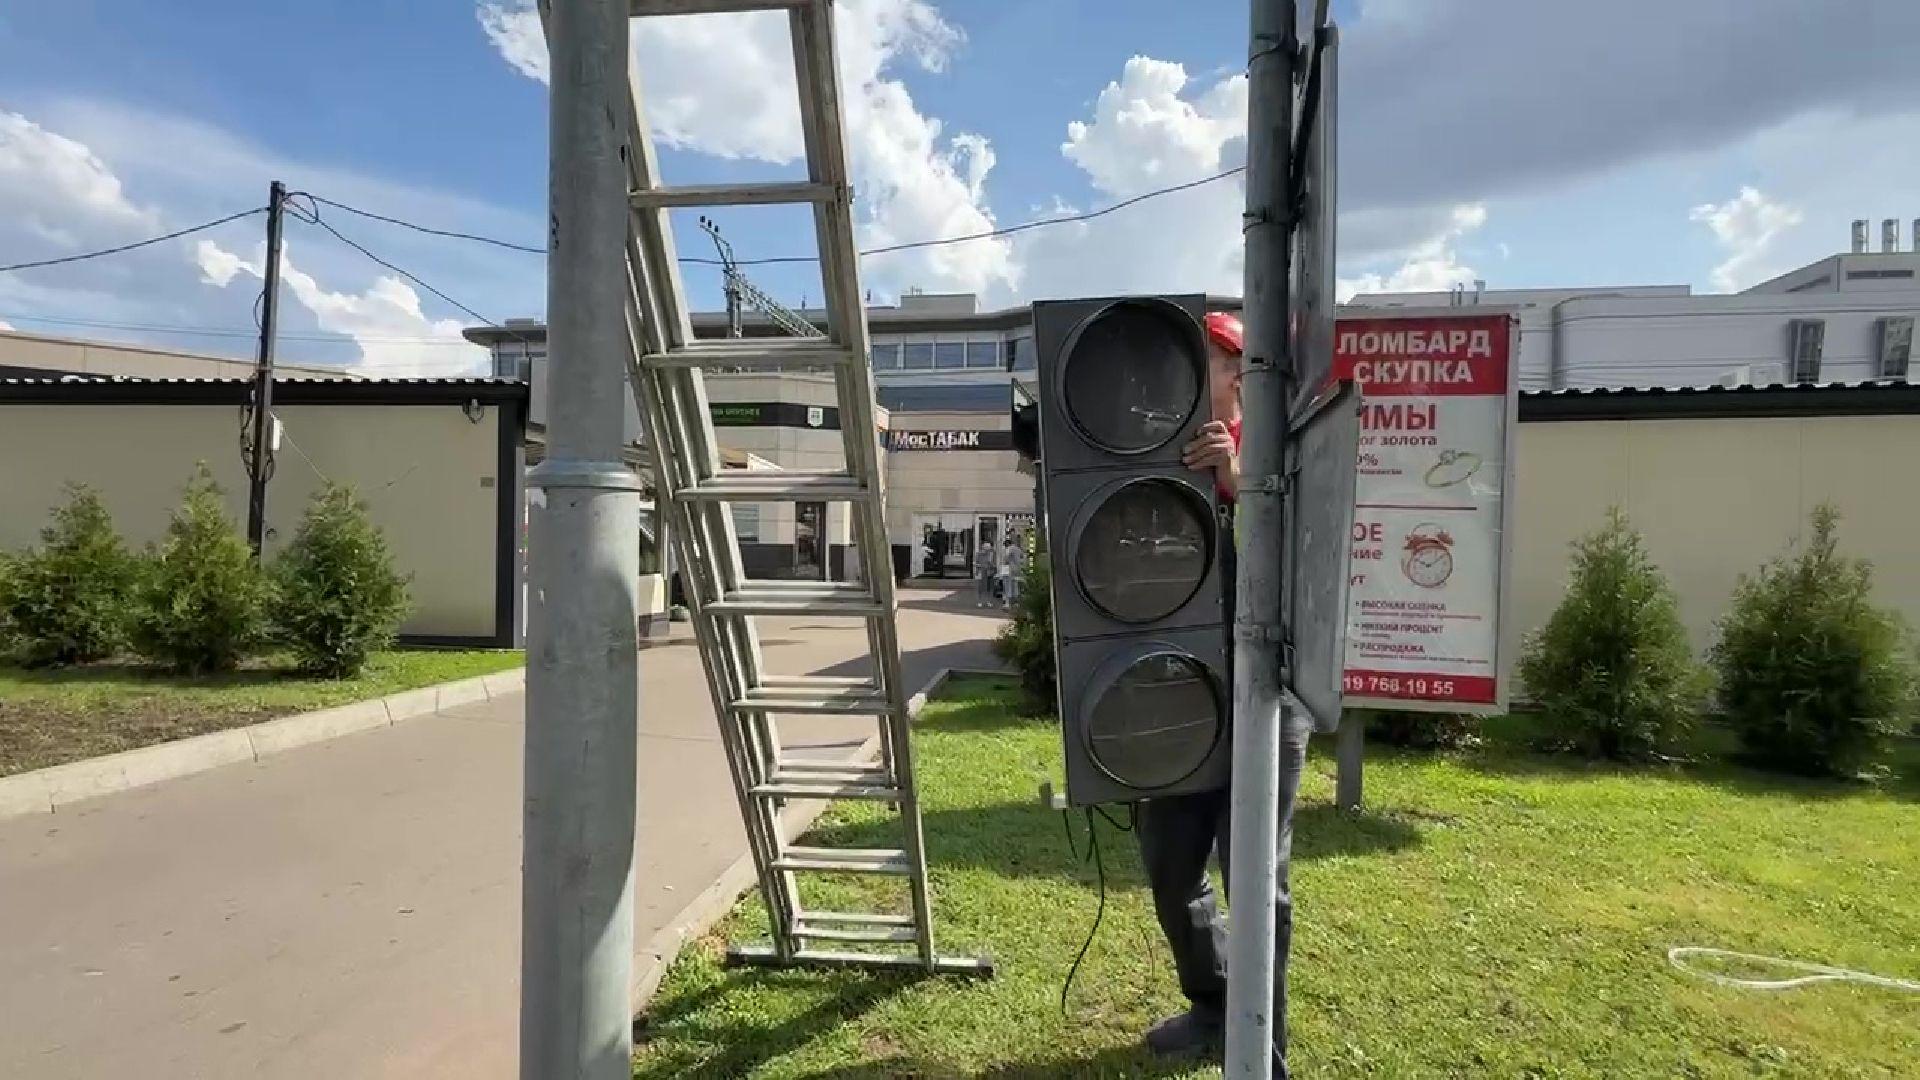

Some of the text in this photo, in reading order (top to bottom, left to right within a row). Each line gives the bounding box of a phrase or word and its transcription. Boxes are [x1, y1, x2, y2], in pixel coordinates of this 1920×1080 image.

[1337, 330, 1491, 358] ЛОМБАРД
[1353, 360, 1474, 383] СКУПКА
[1380, 435, 1438, 446] золота
[1359, 642, 1425, 653] РАСПРОДАЖА
